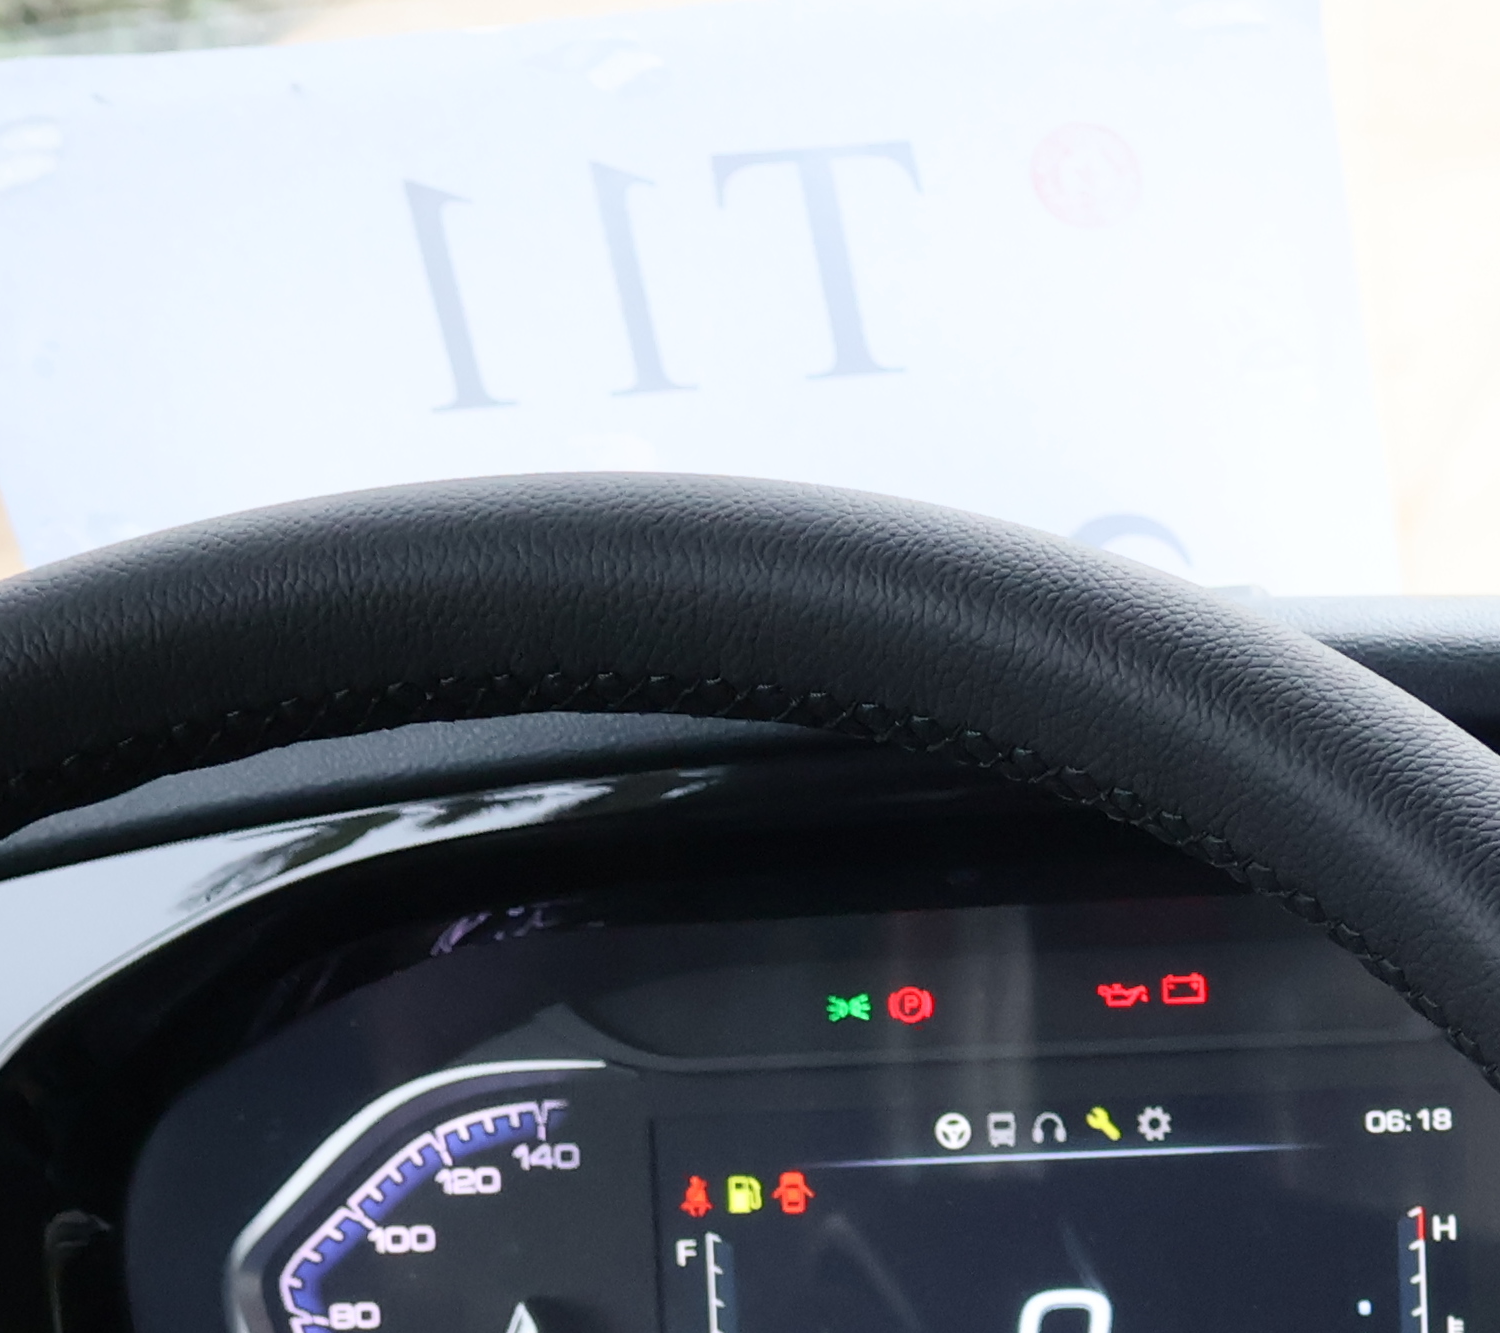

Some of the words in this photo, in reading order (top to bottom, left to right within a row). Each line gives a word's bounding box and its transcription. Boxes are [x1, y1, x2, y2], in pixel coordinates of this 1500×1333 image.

[1365, 1108, 1451, 1133] 06:18
[512, 1143, 580, 1171] 140
[435, 1168, 501, 1195] 120
[368, 1226, 436, 1253] 100
[1432, 1216, 1455, 1241] H
[676, 1240, 697, 1266] F
[328, 1302, 380, 1330] 80
